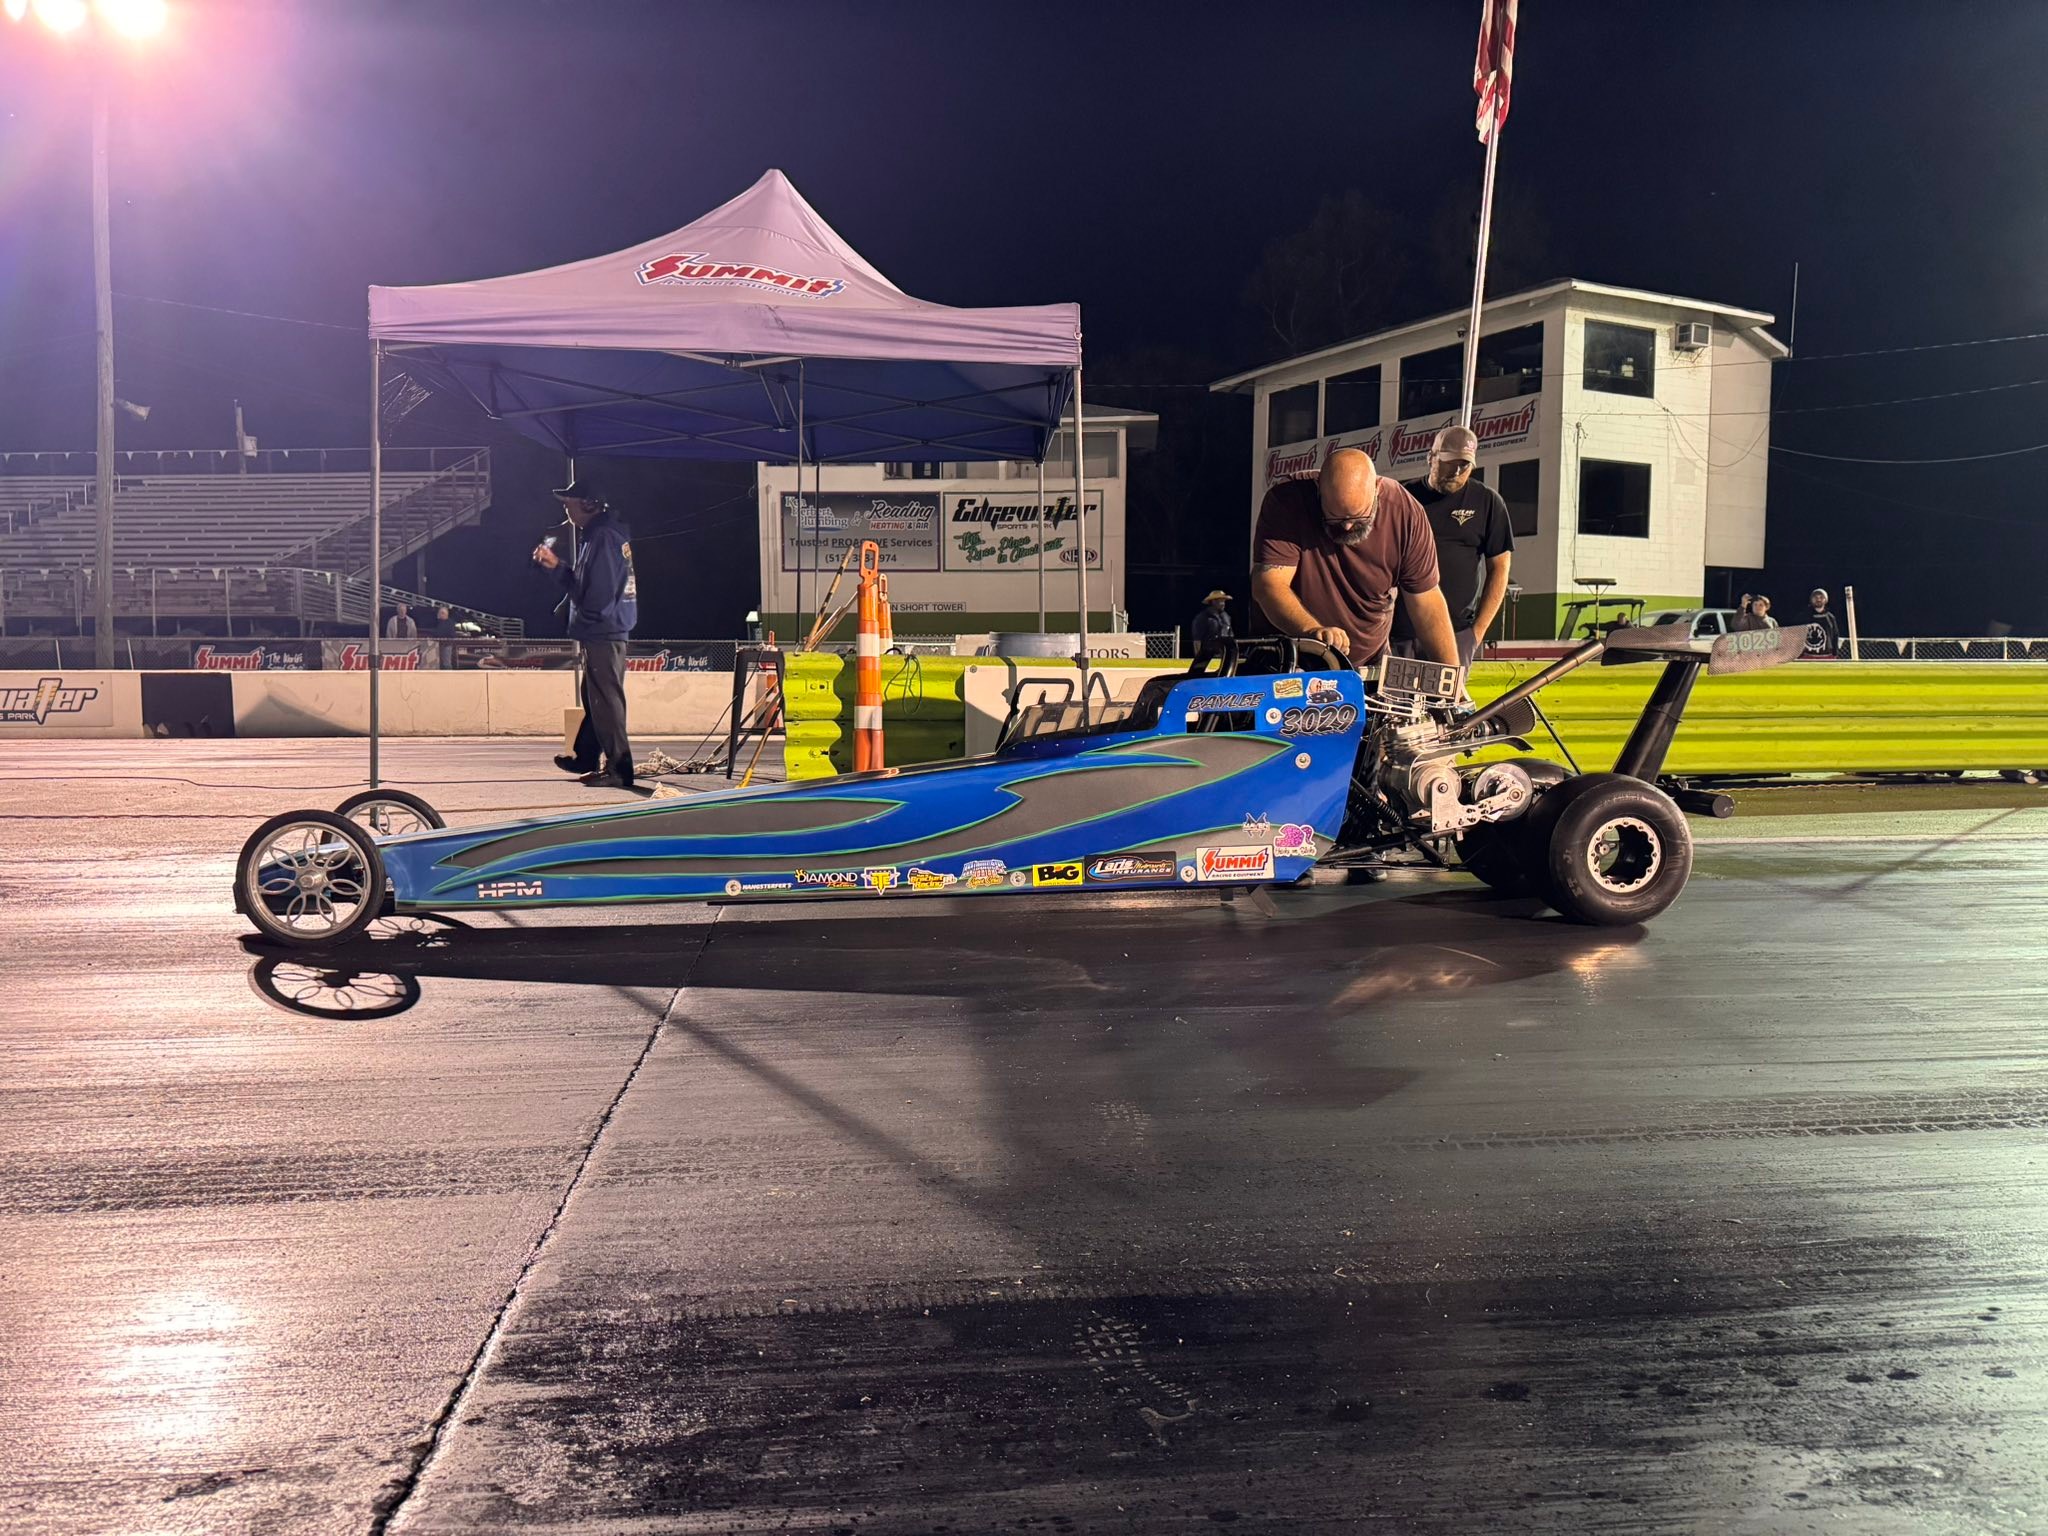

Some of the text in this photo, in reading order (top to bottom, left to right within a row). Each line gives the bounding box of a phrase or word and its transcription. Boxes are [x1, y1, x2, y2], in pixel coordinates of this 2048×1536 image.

[636, 252, 848, 298] SUMMIT
[866, 500, 935, 521] Reading
[952, 496, 1098, 531] Edgewater
[870, 522, 904, 530] HEATING
[915, 521, 929, 529] AIR
[890, 537, 933, 547] Services
[900, 603, 929, 611] SHORT
[932, 603, 963, 611] TOWER
[1727, 632, 1782, 650] 3029
[194, 645, 266, 670] SUMMIT
[1188, 692, 1265, 709] BAYLEE
[8, 712, 35, 720] PARK
[1280, 704, 1358, 738] 3029
[1112, 867, 1172, 875] INSURANCE
[1202, 847, 1269, 878] SUMMIT
[796, 872, 858, 882] DIAMOND
[871, 873, 891, 891] BTE
[478, 881, 542, 898] HPM
